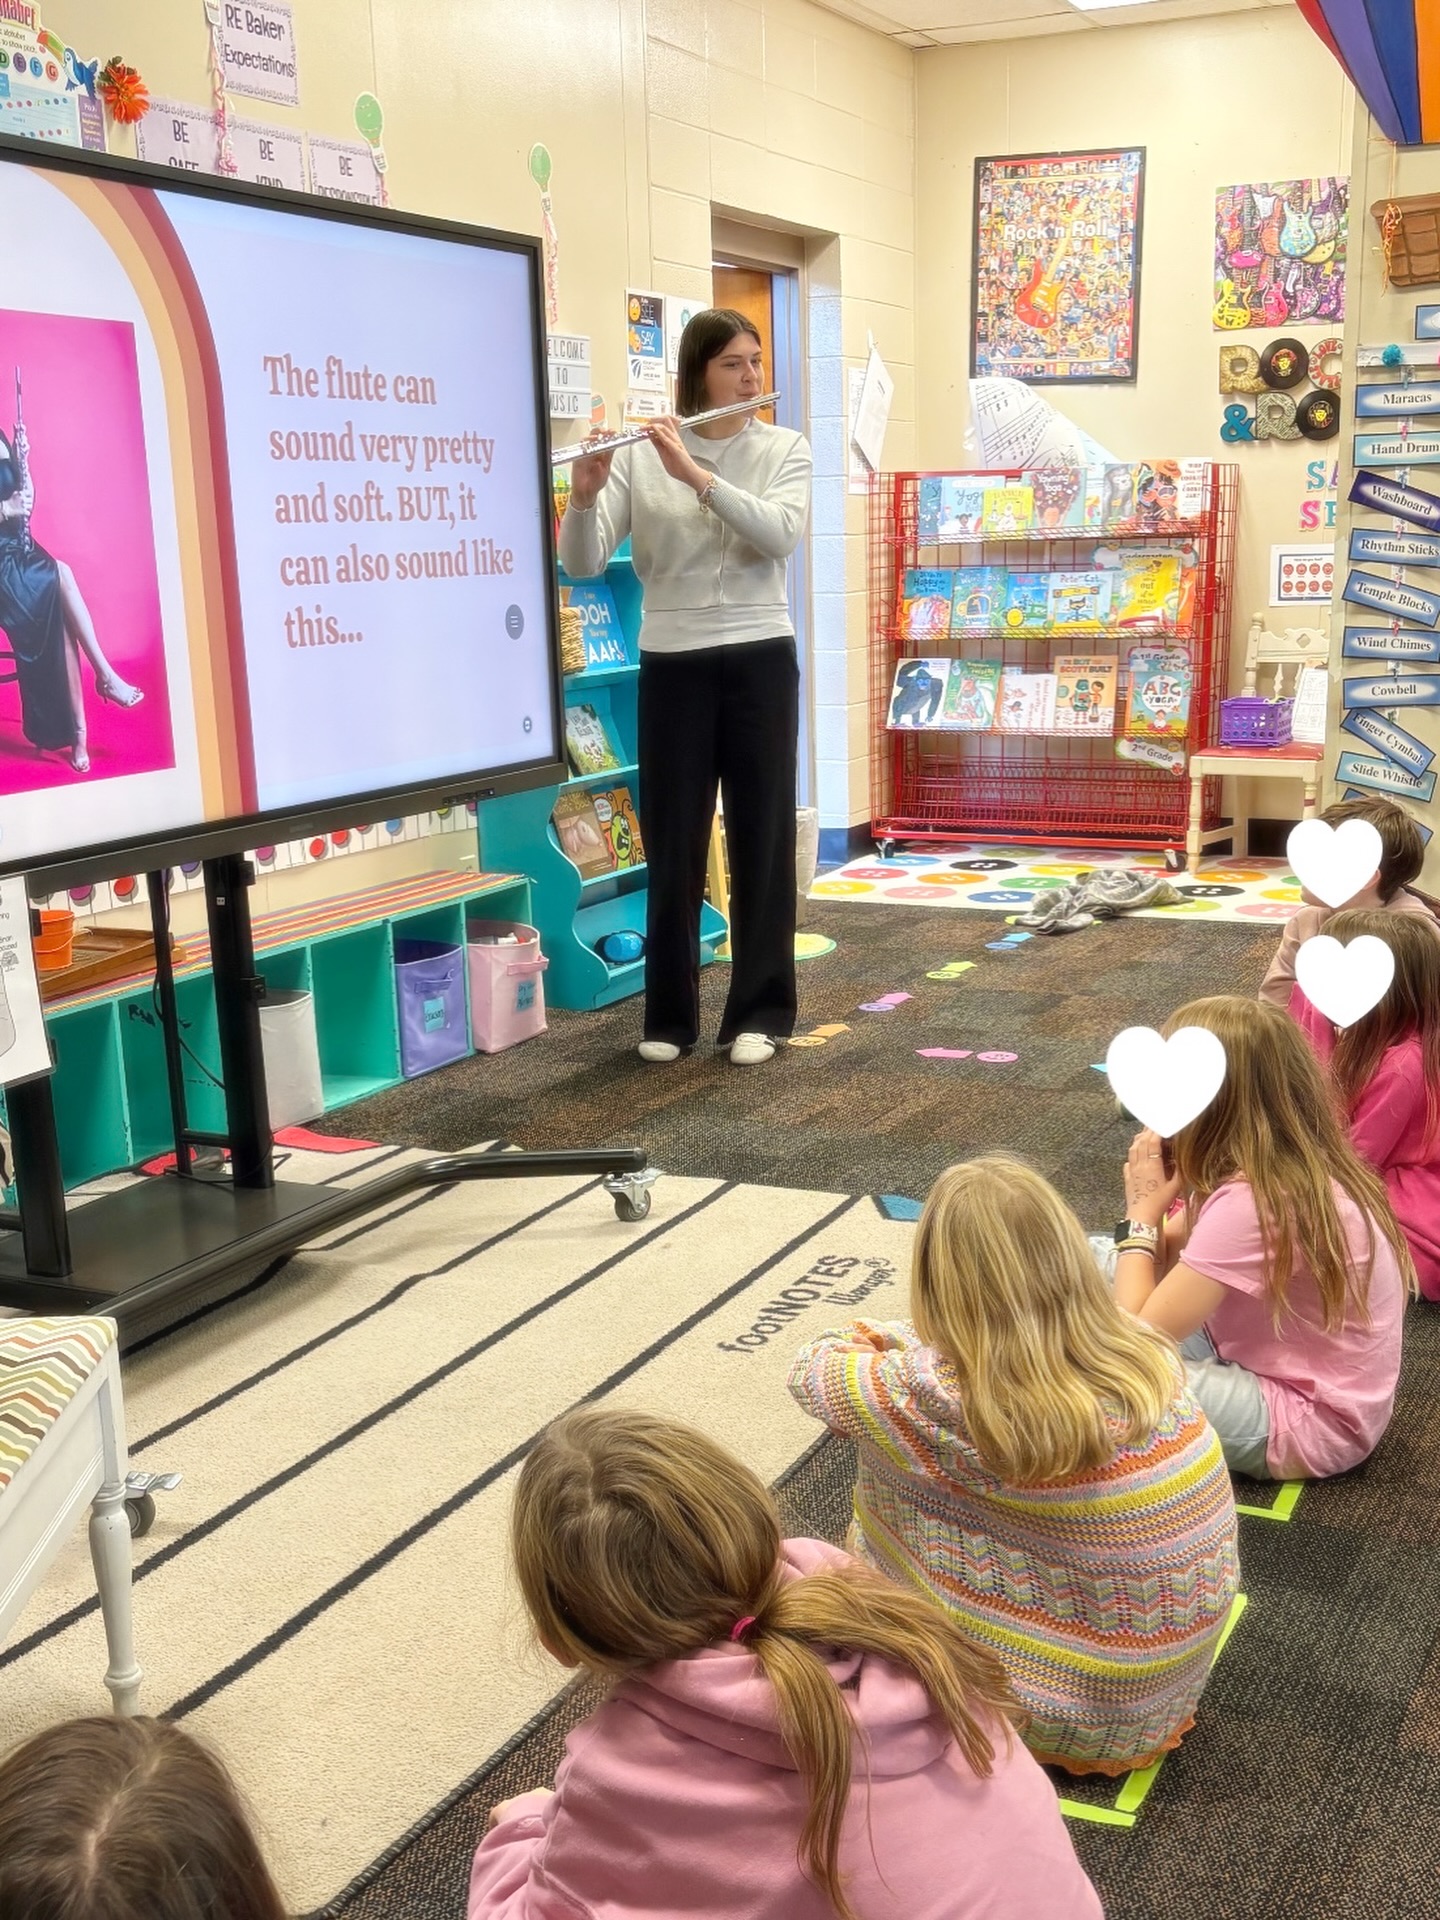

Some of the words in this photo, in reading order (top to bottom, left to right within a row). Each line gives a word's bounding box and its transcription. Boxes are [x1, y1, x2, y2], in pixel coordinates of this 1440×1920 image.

[225, 4, 243, 30] RE
[245, 10, 285, 41] Baker
[224, 44, 295, 78] Expectations
[172, 119, 190, 143] BE
[259, 139, 275, 161] BE
[339, 155, 353, 177] BE
[1072, 219, 1109, 238] Roll
[547, 339, 584, 360] ELCOME
[263, 353, 319, 398] The
[325, 355, 387, 402] flute
[393, 374, 437, 405] can
[556, 367, 568, 385] TO
[1383, 392, 1432, 405] Maracas
[269, 420, 357, 462] sound
[359, 432, 418, 473] very
[422, 430, 495, 474] pretty
[1371, 443, 1403, 455] Hand
[1406, 442, 1440, 453] Drum
[275, 481, 329, 524] and
[334, 480, 393, 523] soft.
[396, 486, 456, 531] BUT,
[459, 482, 477, 521] it
[1372, 485, 1432, 516] Washboard
[1361, 539, 1405, 553] Rhythm
[1407, 543, 1440, 557] Sticks
[280, 553, 330, 587] can
[336, 543, 390, 583] also
[395, 539, 468, 580] sound
[472, 538, 514, 577] like
[1356, 581, 1397, 602] Temple
[1398, 595, 1433, 614] Blocks
[284, 603, 363, 649] this...
[1357, 636, 1387, 649] Wind
[1390, 638, 1431, 651] Chimes
[1143, 681, 1181, 696] ABC
[1371, 684, 1417, 697] Cowbell
[1353, 713, 1386, 739] Finger
[1386, 732, 1426, 767] Cymbals
[1147, 748, 1173, 762] Grade
[1351, 762, 1379, 779] Slide
[1381, 768, 1423, 789] Whistle
[717, 1255, 861, 1353] footNOTES
